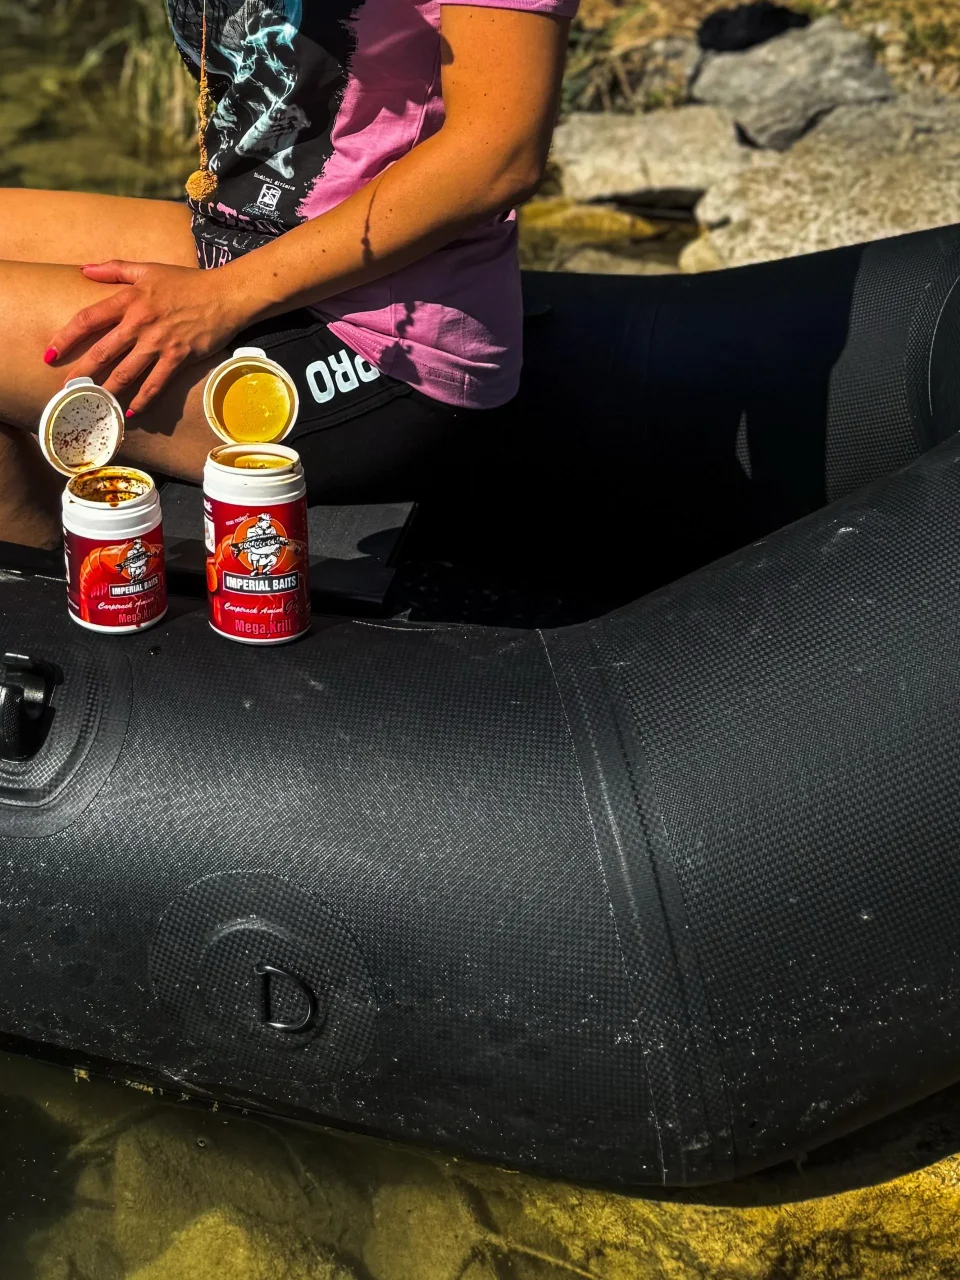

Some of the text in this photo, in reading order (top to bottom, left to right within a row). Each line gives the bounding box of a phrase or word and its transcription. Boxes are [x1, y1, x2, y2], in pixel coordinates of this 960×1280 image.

[305, 349, 381, 404] PRO
[111, 584, 143, 595] IMPERIAL
[144, 576, 159, 590] BAITS
[226, 575, 297, 591] IMPERIAL BAITS
